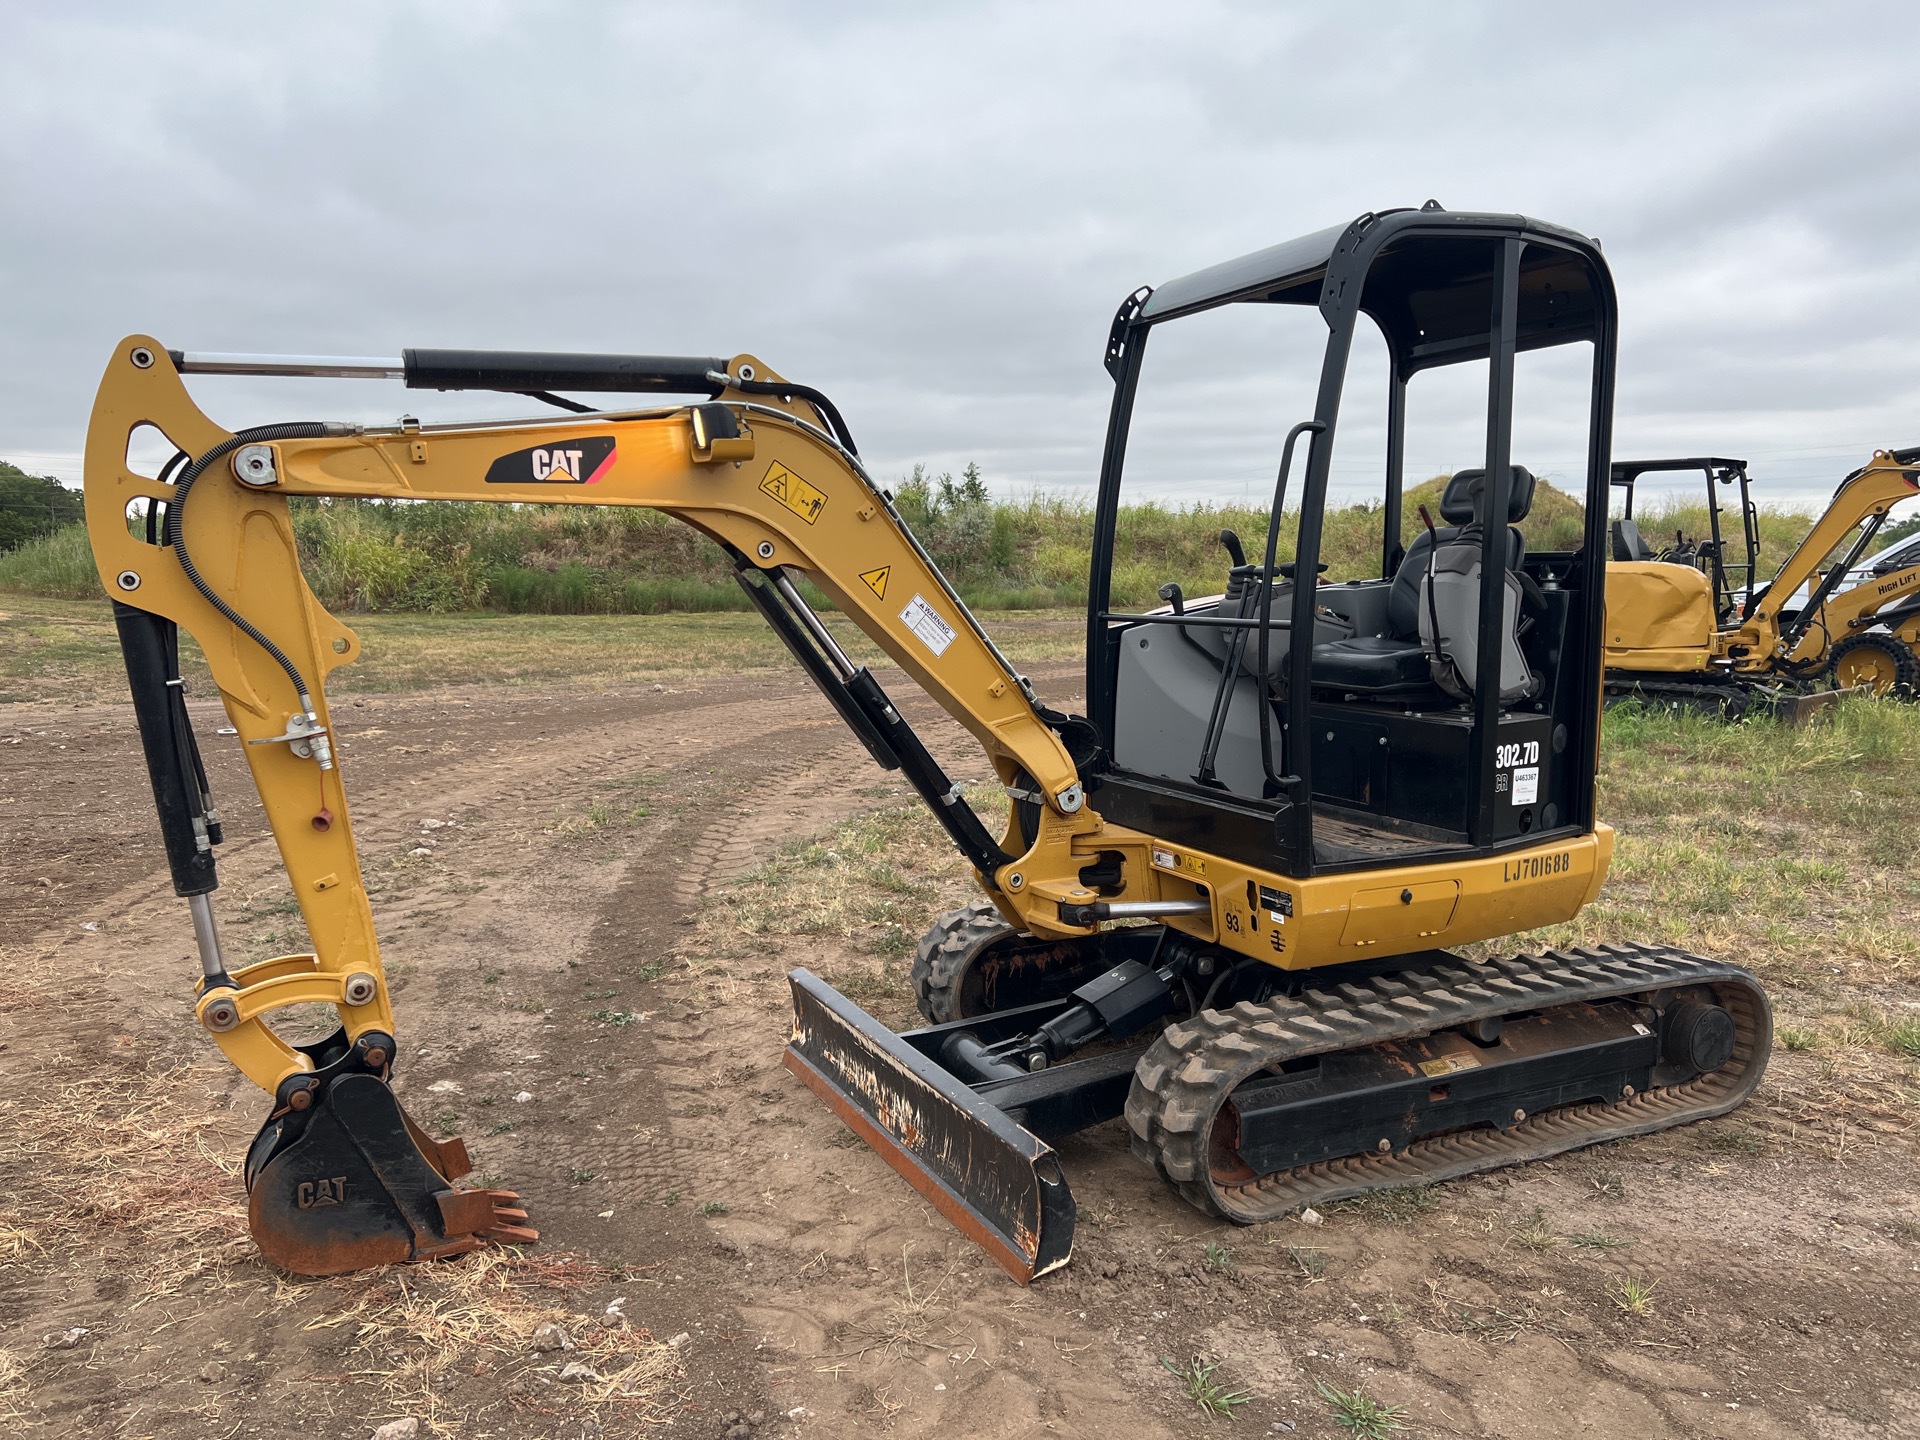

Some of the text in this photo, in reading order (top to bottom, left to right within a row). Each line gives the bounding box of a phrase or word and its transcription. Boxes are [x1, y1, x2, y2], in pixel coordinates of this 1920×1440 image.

[531, 448, 583, 481] CAT
[1878, 573, 1916, 595] HIGH LIFT
[924, 606, 950, 634] WARNING
[1495, 741, 1539, 769] 302.7D
[1503, 852, 1570, 883] LJ701688
[1226, 912, 1239, 933] 93
[297, 1175, 347, 1209] CAT
